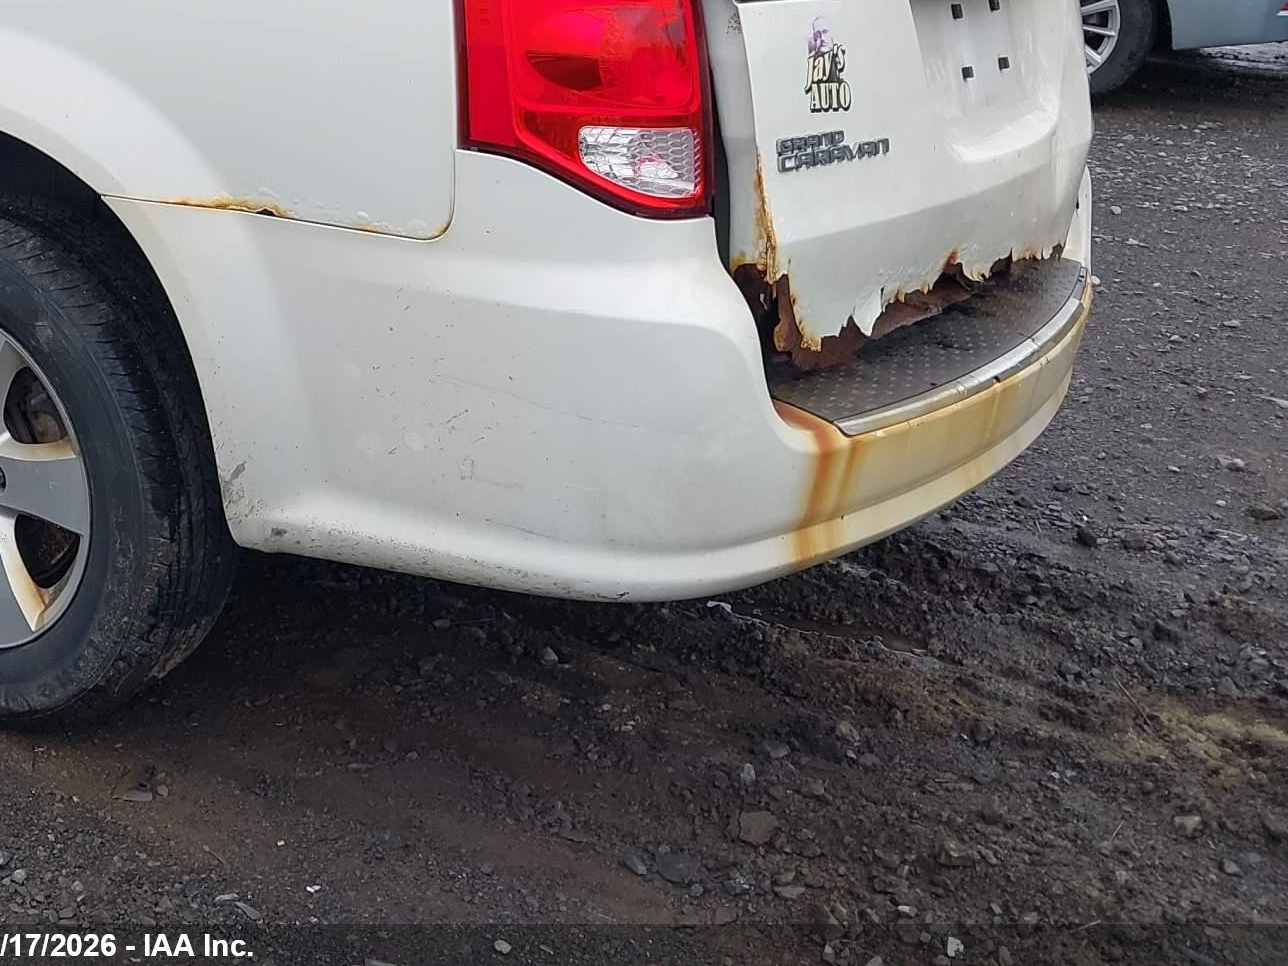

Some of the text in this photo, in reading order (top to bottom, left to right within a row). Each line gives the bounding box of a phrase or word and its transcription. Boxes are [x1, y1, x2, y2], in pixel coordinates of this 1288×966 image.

[809, 80, 852, 114] AUTO
[776, 130, 845, 155] GRAND
[776, 138, 890, 173] CARAVAN
